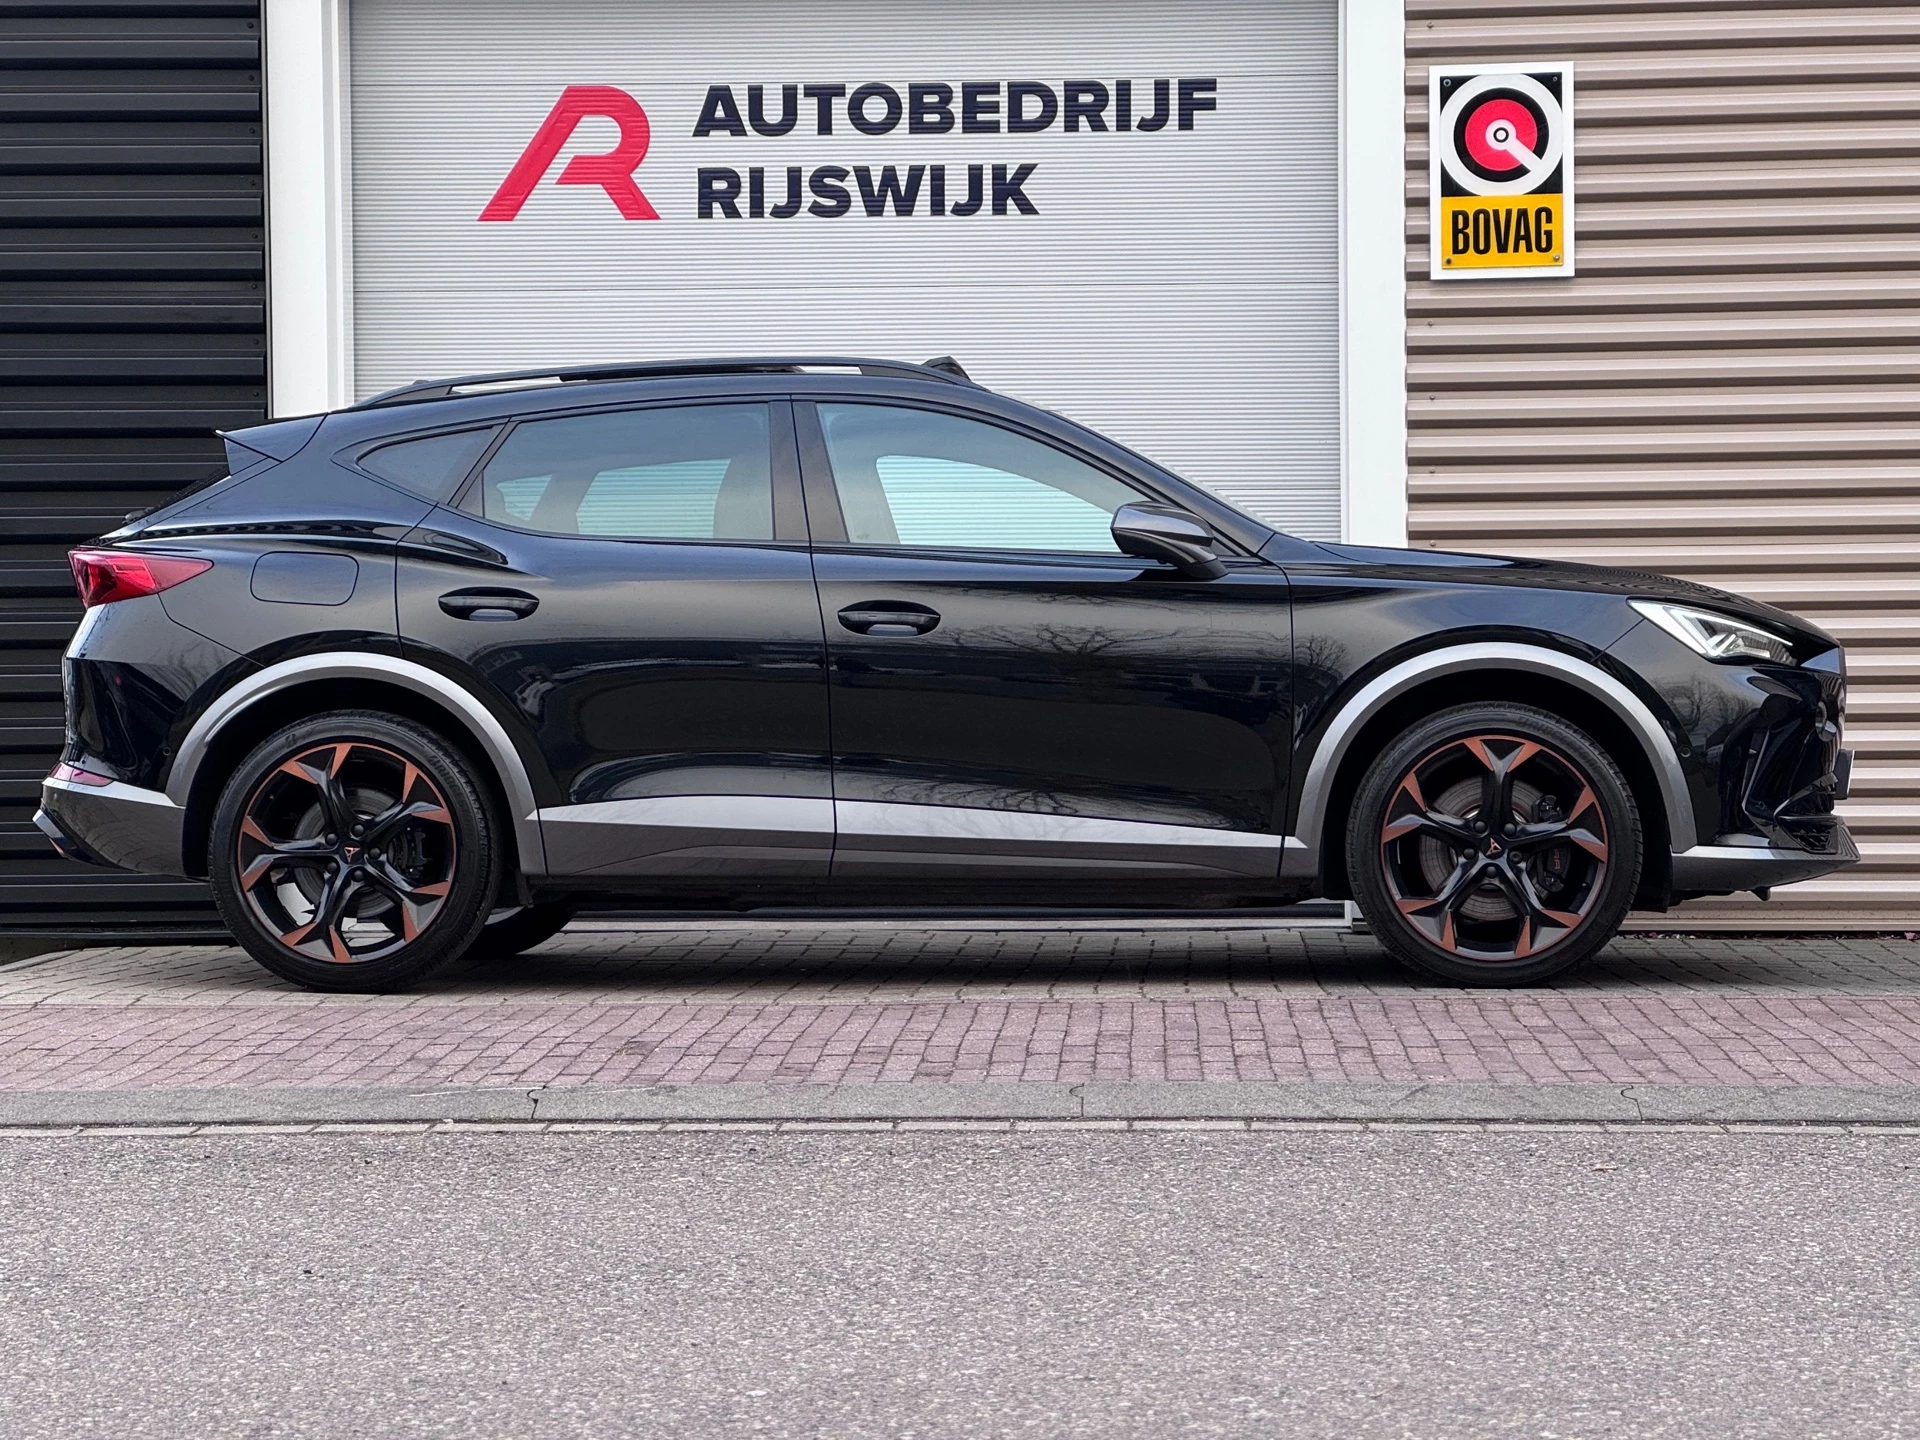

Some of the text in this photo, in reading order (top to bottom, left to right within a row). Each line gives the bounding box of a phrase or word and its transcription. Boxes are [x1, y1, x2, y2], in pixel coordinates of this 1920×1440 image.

[692, 78, 1217, 137] AUTOBEDRIJF
[697, 163, 1040, 219] RIJSWIJK
[1452, 206, 1553, 255] BOVAG
